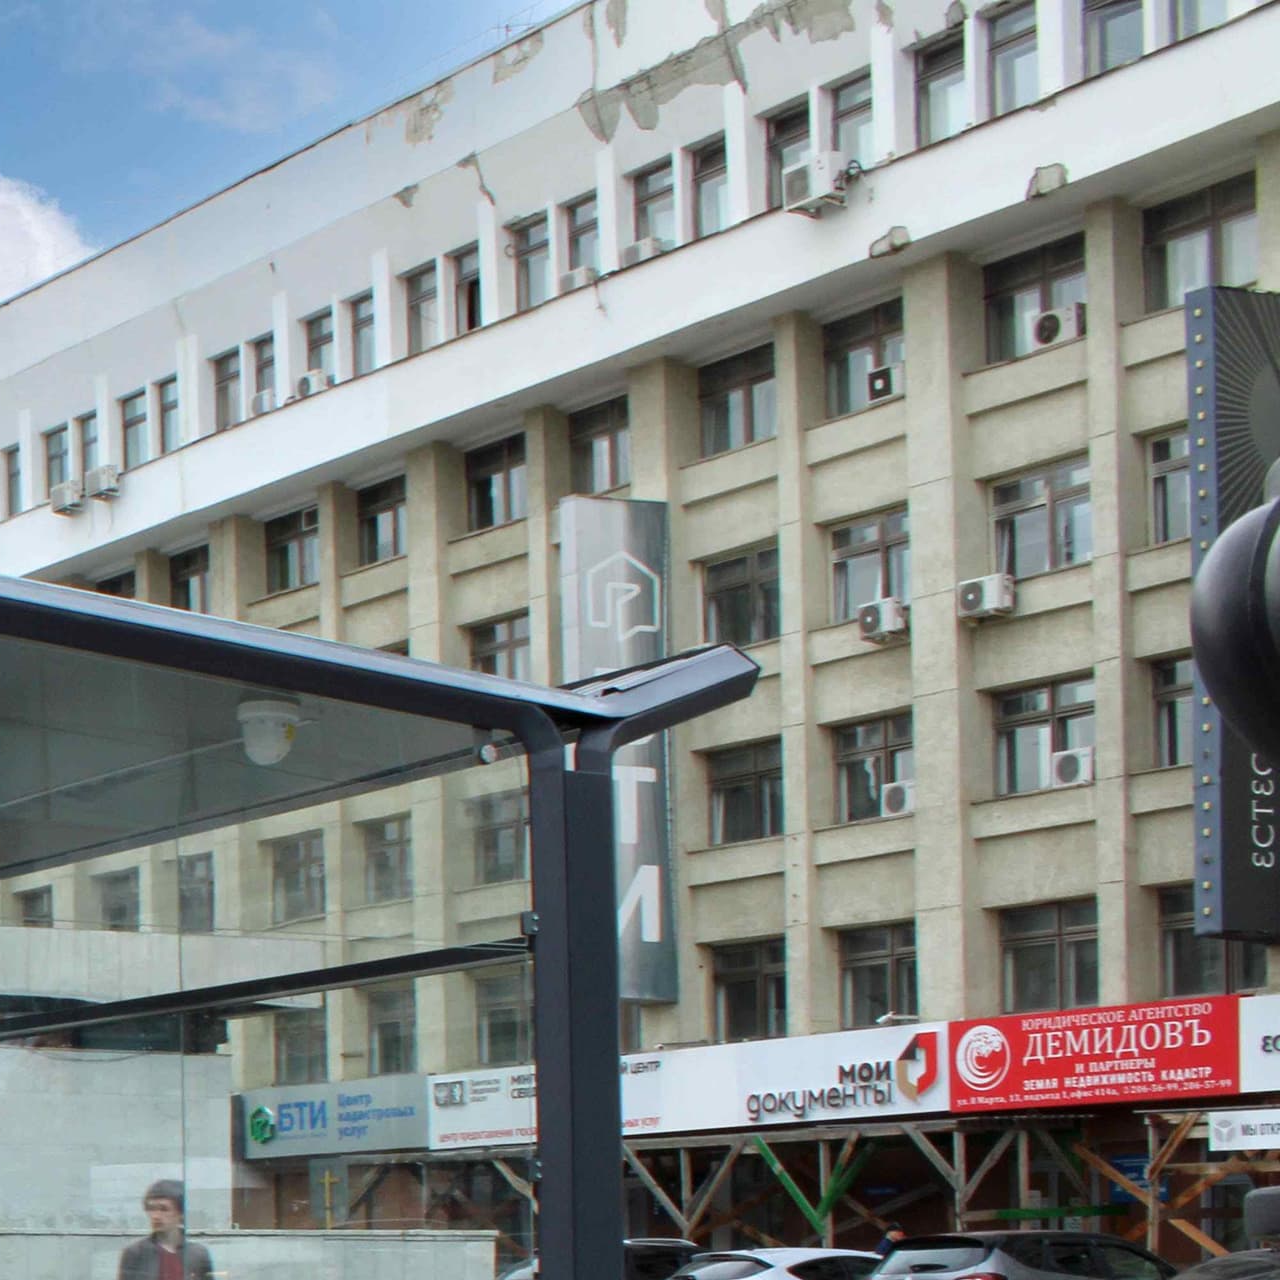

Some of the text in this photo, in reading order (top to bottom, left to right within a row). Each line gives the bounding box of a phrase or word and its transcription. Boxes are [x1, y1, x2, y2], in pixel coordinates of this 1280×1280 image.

[1022, 1002, 1212, 1031] ЮРИДИЧЕСКОЕ АГЕНТСТВО
[1022, 1019, 1212, 1067] ДЕМИДОВЪ
[630, 1060, 661, 1074] ЦЕНТР
[838, 1060, 892, 1084] мои
[1023, 1066, 1213, 1091] ЗЕМЛЯ НЕДВИЖИМОСТЬ КАДАСТР
[1075, 1058, 1156, 1073] И ПАРТНЕРЫ
[746, 1083, 893, 1121] документы
[277, 1101, 327, 1132] БТИ
